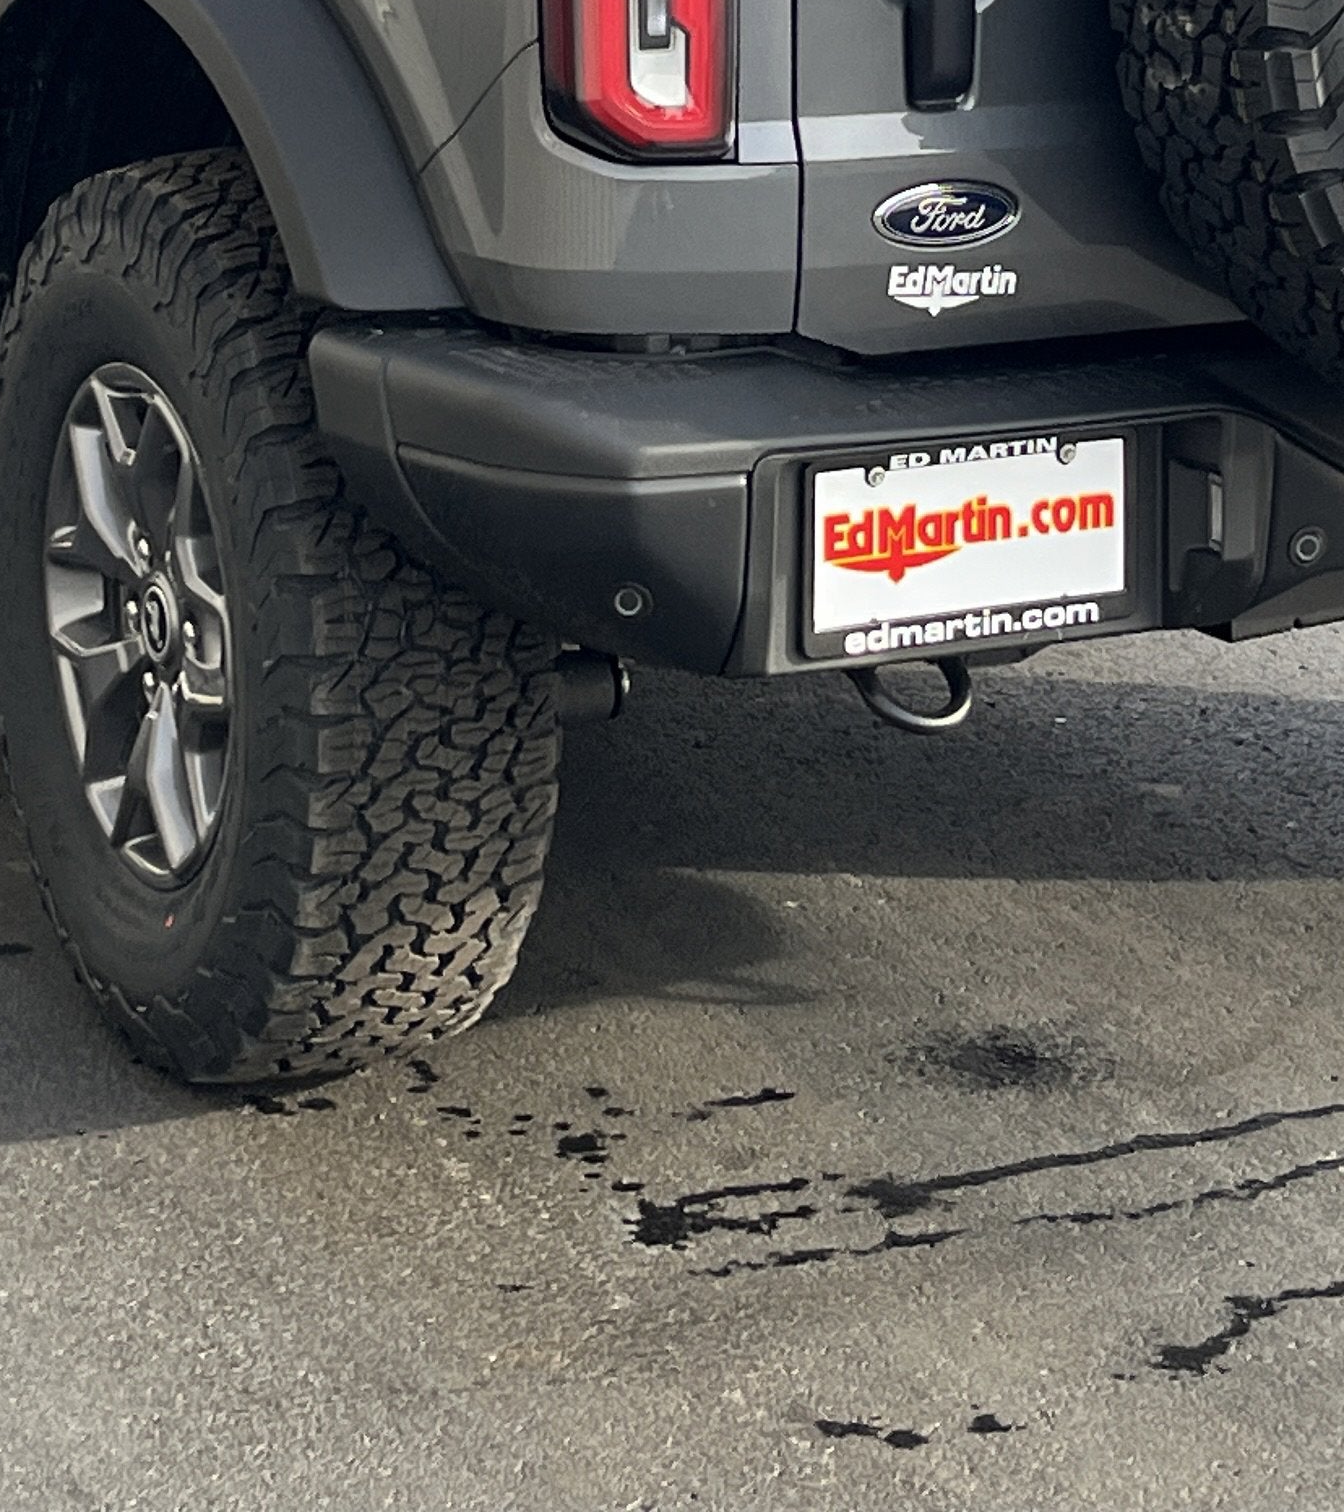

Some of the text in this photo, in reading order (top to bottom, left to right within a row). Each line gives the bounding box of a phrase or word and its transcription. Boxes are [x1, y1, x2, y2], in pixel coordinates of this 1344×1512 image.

[910, 195, 987, 234] Ford
[887, 264, 1017, 297] EdMartin
[889, 437, 1058, 470] ED MARTIN
[844, 600, 1100, 656] edmartin.com
